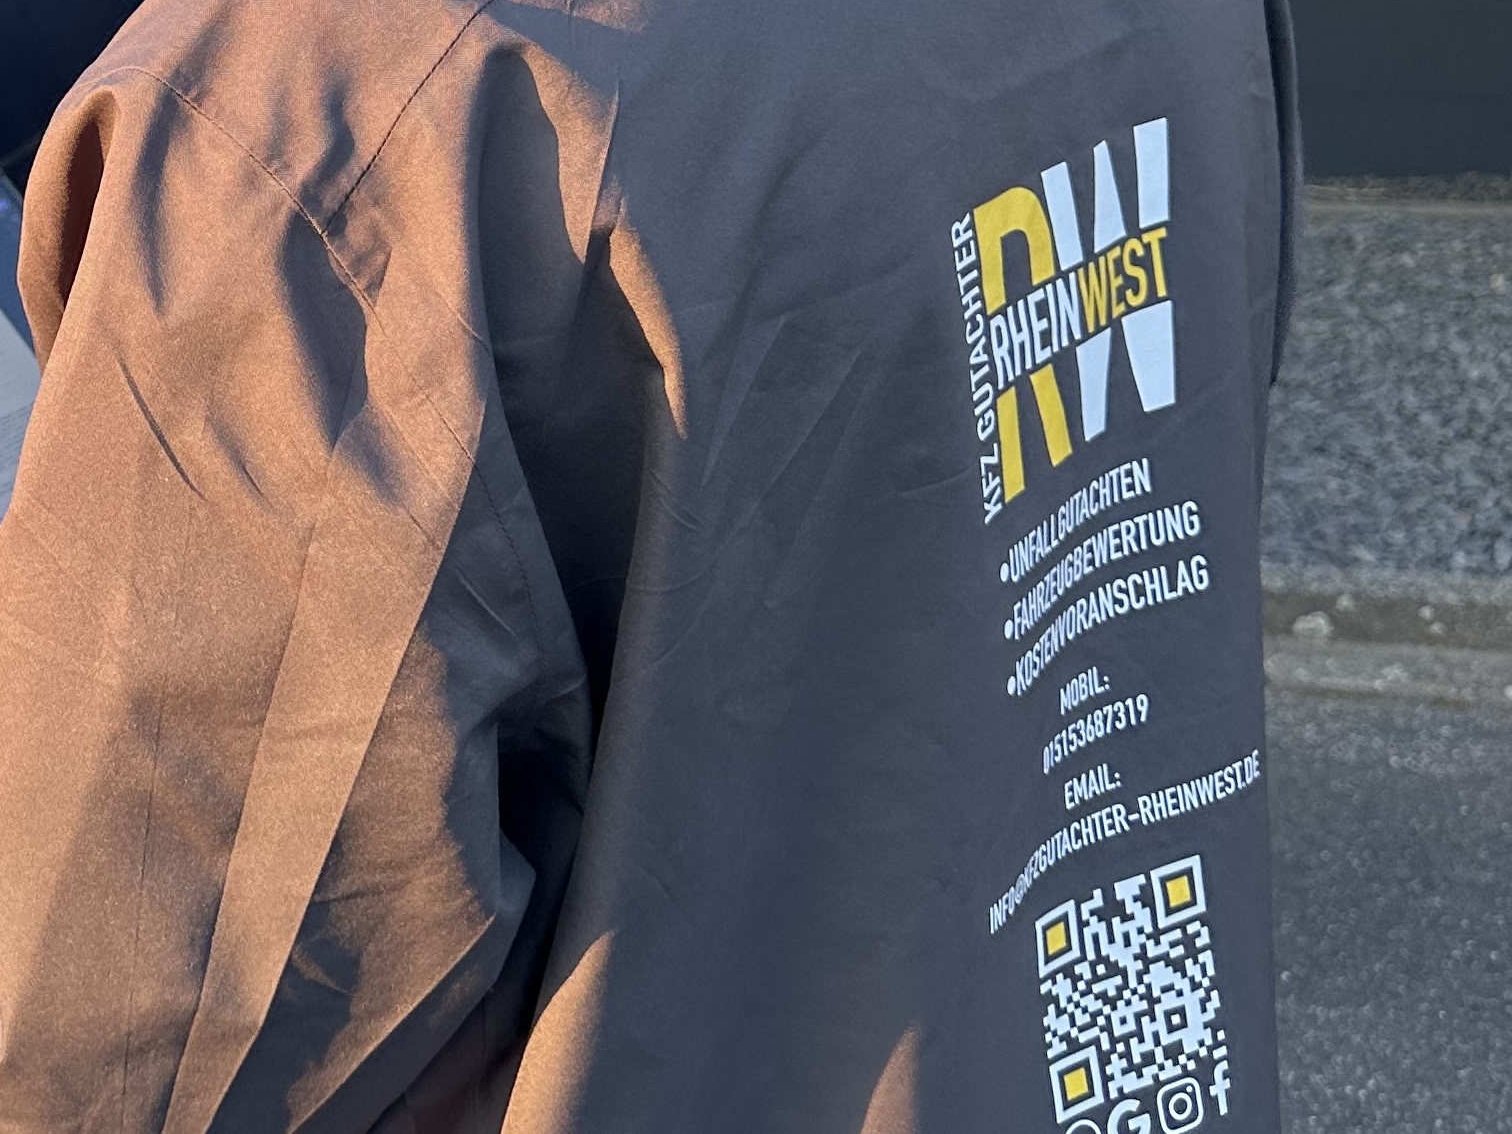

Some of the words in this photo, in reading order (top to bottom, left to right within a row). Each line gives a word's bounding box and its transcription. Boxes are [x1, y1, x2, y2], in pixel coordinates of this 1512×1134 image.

[950, 212, 996, 442] GUTACHTER
[989, 227, 1168, 391] RHEINWEST
[979, 442, 1003, 525] KFZ
[1059, 665, 1112, 716] MOBIL:
[1042, 693, 1149, 775] 015153687319
[1064, 763, 1123, 811] EMAIL:
